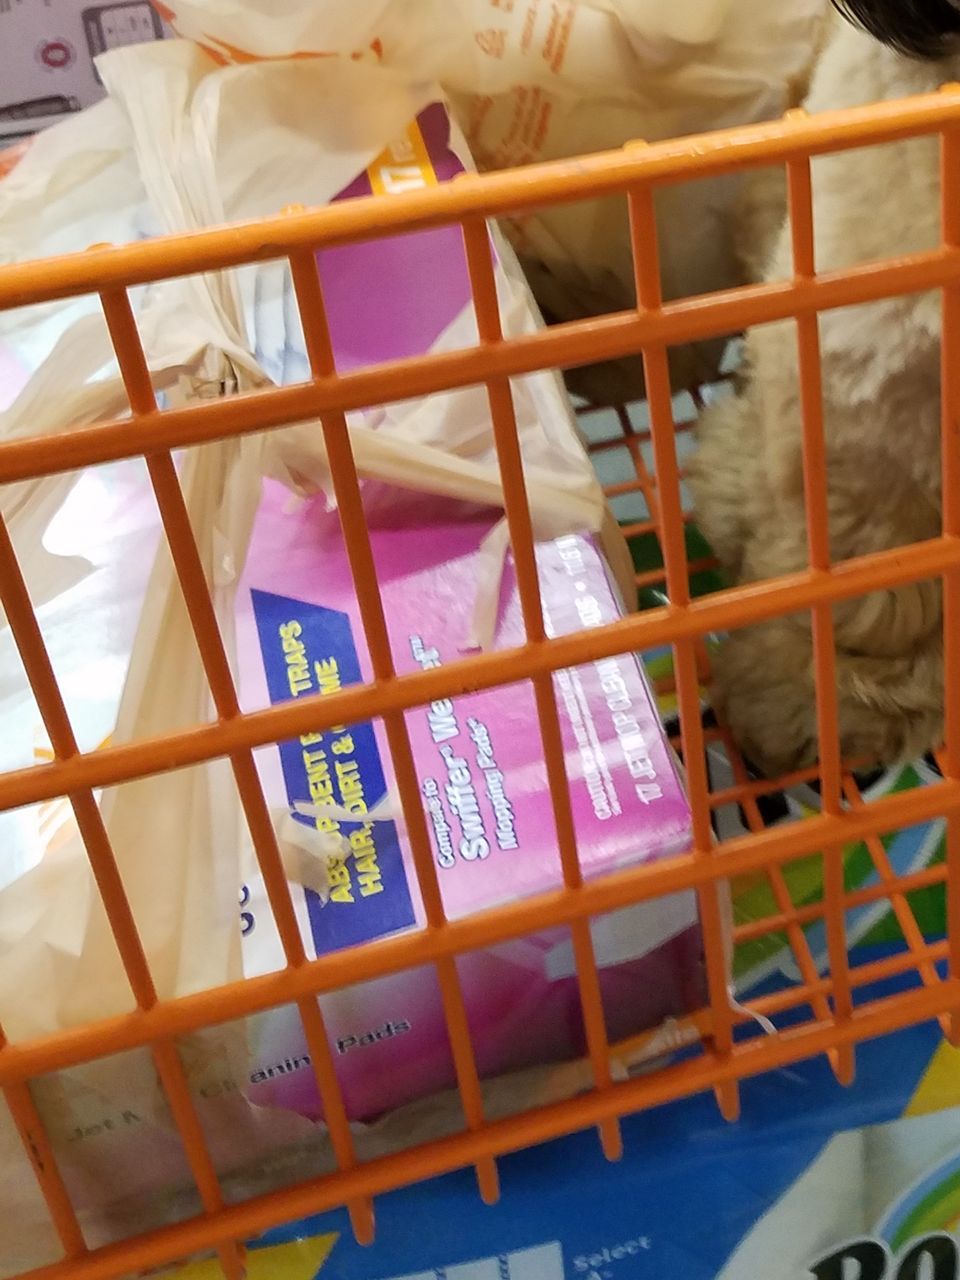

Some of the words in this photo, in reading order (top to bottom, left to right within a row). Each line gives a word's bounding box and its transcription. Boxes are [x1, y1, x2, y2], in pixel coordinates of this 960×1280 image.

[280, 620, 312, 697] TRAPS
[331, 733, 355, 755] &
[335, 760, 369, 820] DIRT
[423, 777, 438, 797] to
[484, 768, 520, 851] Mopping
[427, 797, 456, 869] Compare
[336, 1019, 402, 1055] Pads
[573, 1235, 650, 1271] Select
